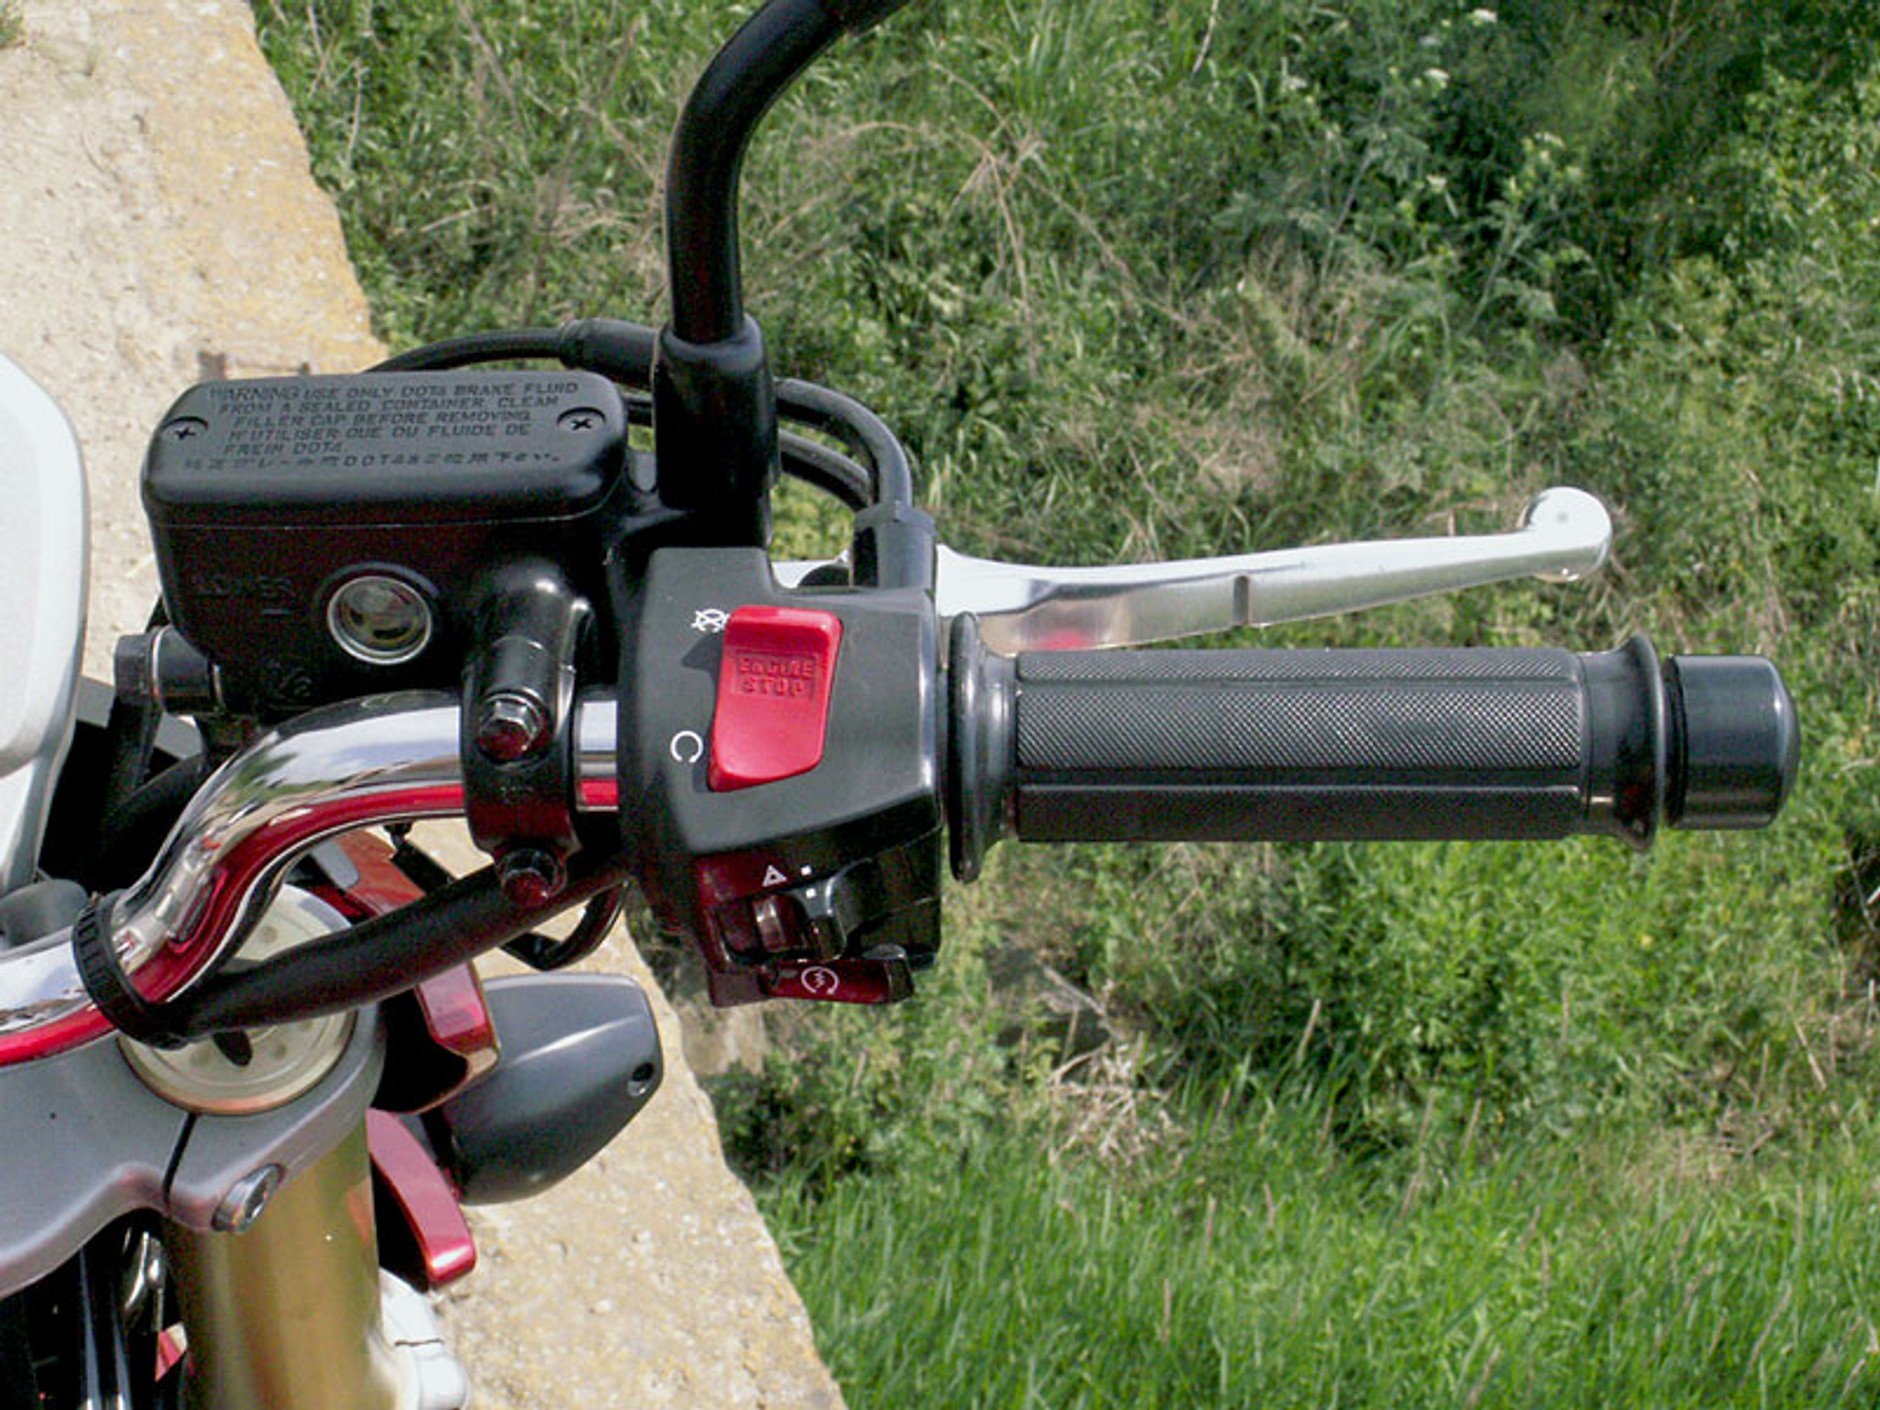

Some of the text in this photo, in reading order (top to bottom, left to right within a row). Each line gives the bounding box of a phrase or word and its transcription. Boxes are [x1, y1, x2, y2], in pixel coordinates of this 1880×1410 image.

[346, 386, 394, 399] ONLY
[454, 383, 516, 396] BRAKE
[523, 381, 579, 394] FLUID
[219, 402, 273, 415] FROM
[299, 400, 371, 413] SEALED
[498, 395, 559, 408] CLEAN
[233, 410, 531, 429] FILLER CAP BEFORE REMOVING
[427, 423, 496, 437] FLUIDE
[223, 443, 284, 455] FREIN
[744, 677, 804, 696] STOP
